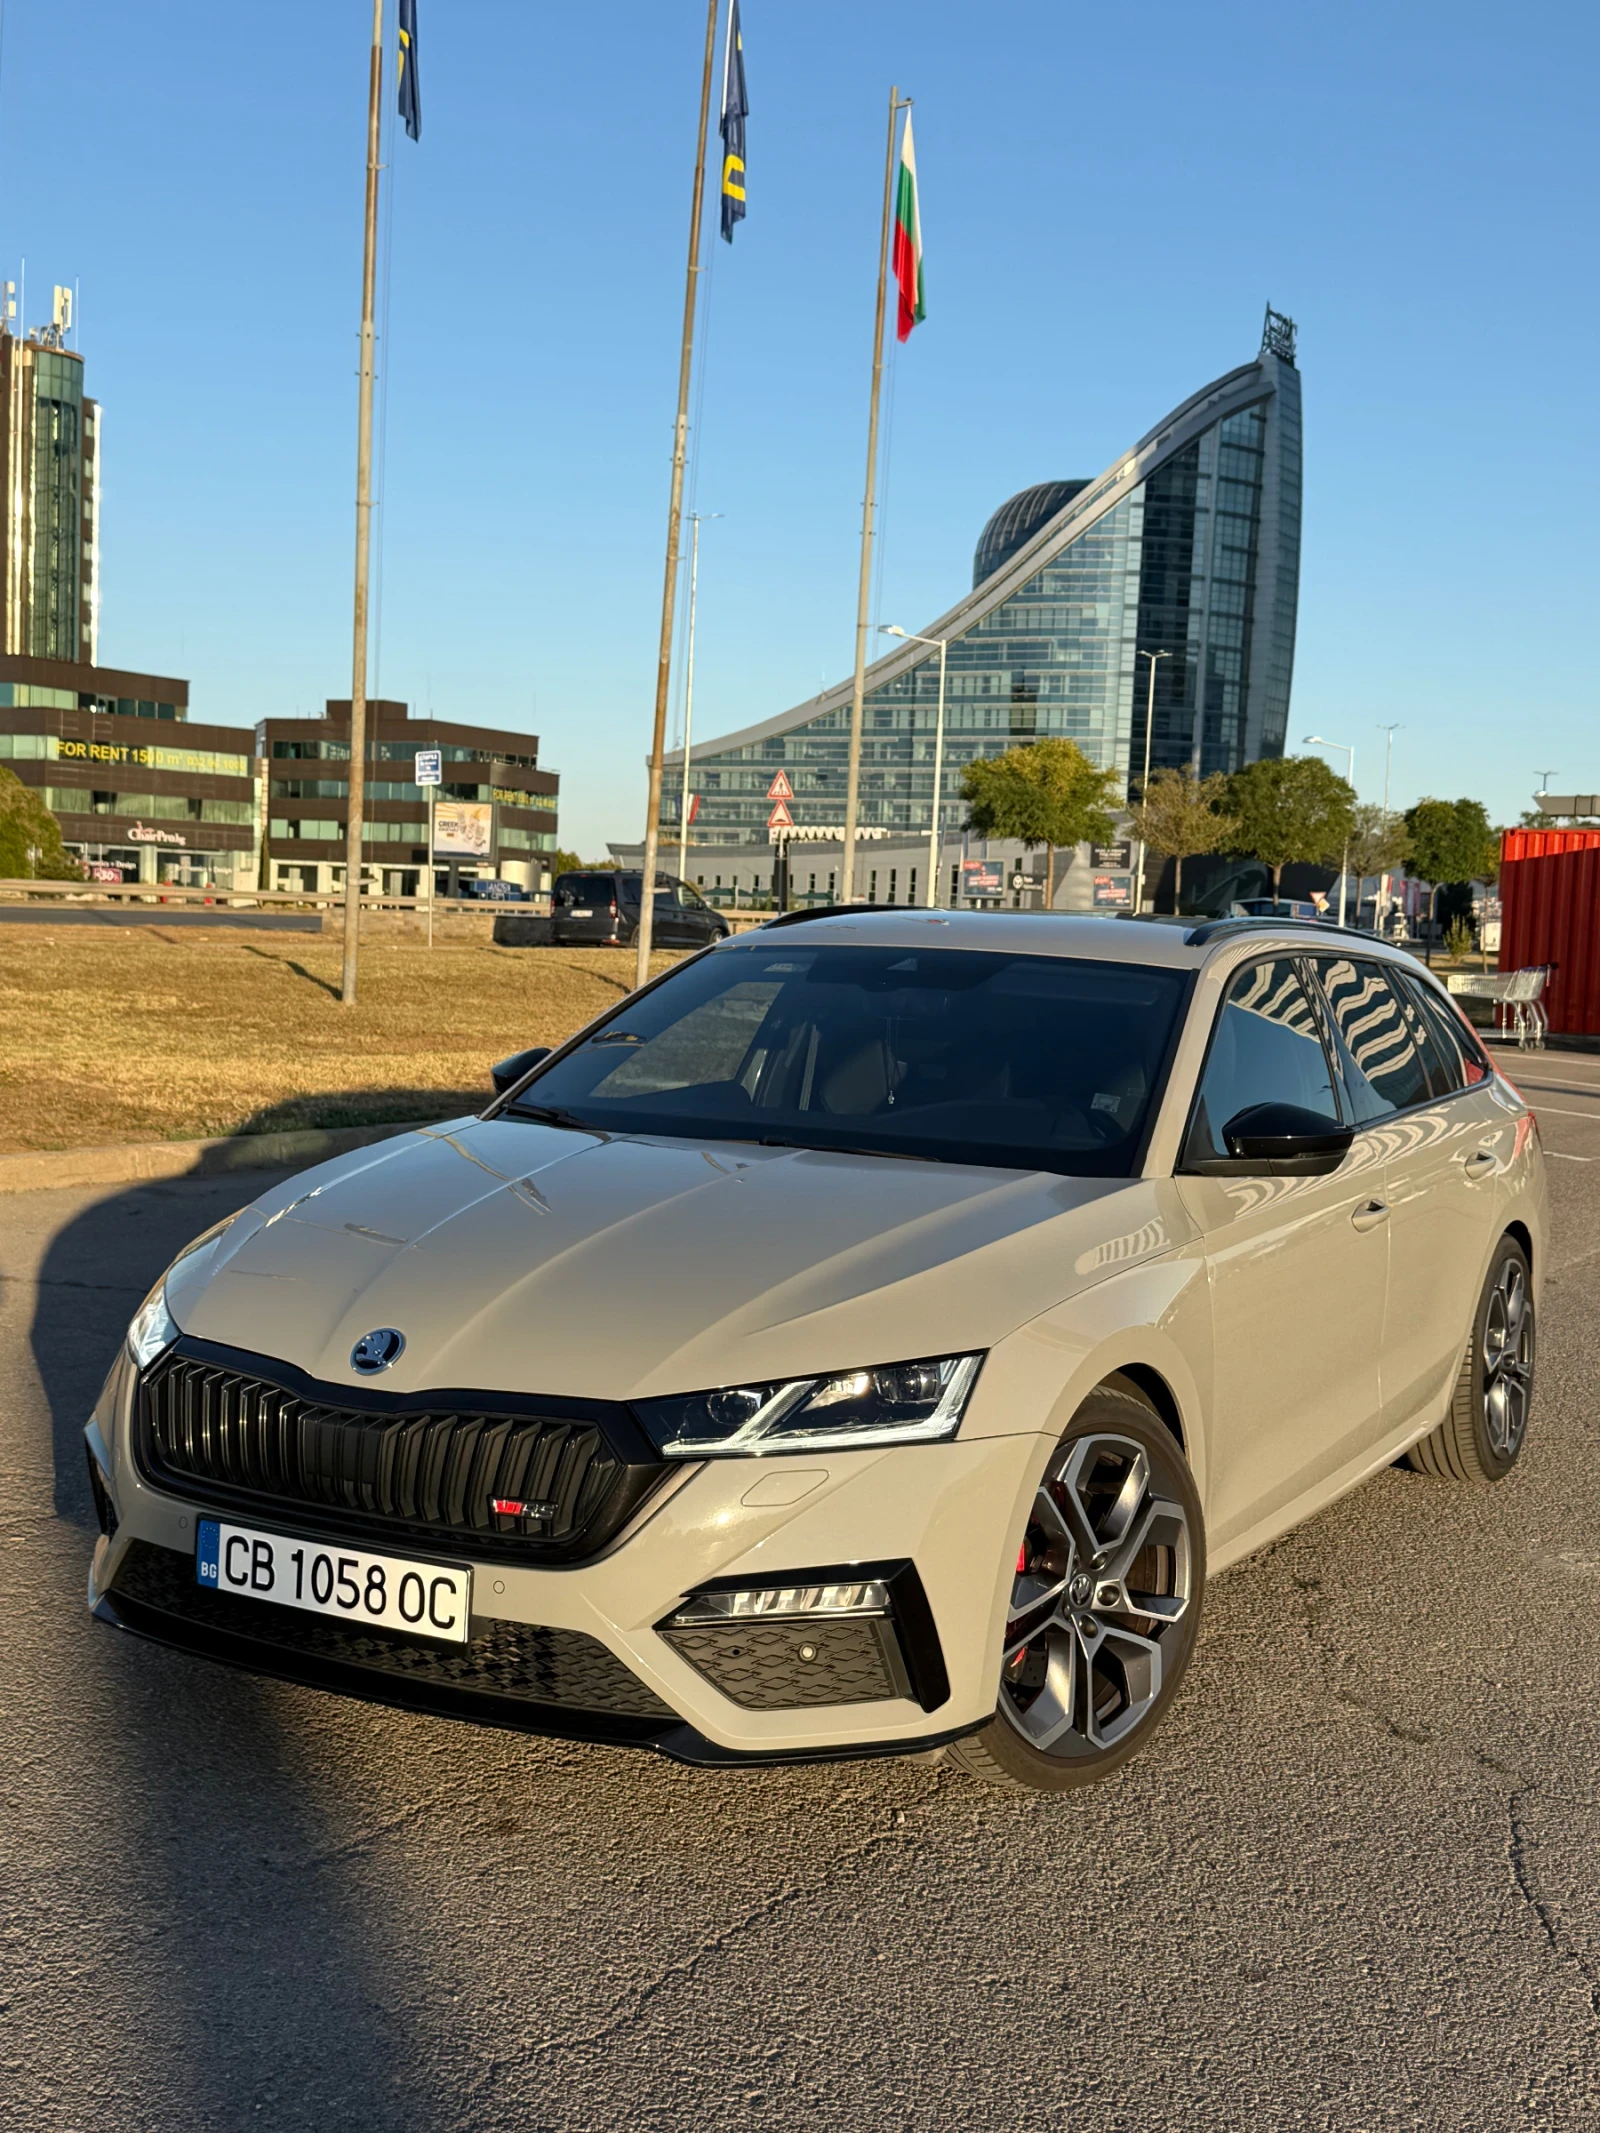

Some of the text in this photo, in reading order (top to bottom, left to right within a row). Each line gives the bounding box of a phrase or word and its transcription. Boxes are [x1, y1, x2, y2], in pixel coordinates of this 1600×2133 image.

[56, 741, 86, 758] FOR
[89, 744, 129, 761] RENT
[201, 1561, 217, 1579] BG
[225, 1535, 275, 1592] CB
[291, 1548, 386, 1615] 1058
